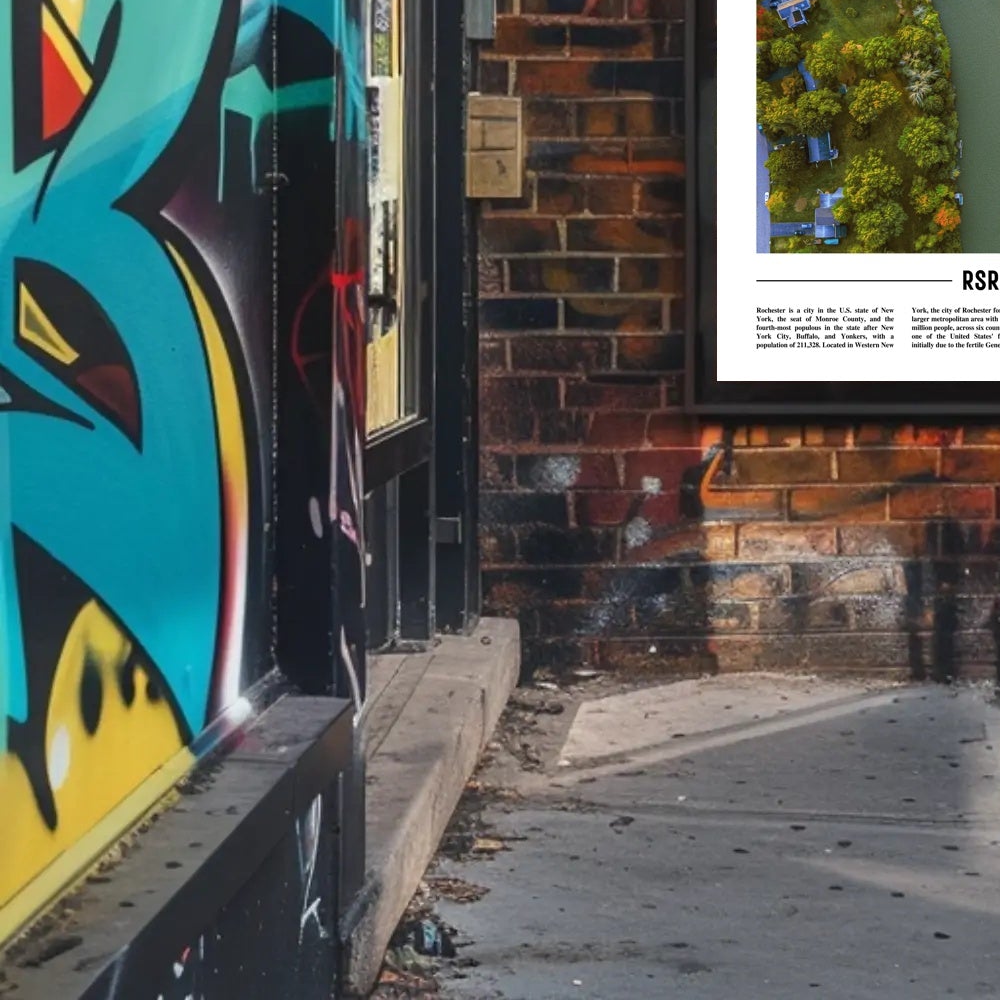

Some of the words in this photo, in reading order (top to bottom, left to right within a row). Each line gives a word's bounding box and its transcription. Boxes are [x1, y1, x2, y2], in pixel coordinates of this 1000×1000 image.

[962, 269, 1000, 291] RSR
[803, 307, 815, 315] city
[941, 307, 953, 315] city
[776, 315, 787, 323] the
[805, 315, 813, 323] of
[815, 315, 839, 323] Monroe
[869, 315, 882, 323] and
[884, 315, 895, 323] the
[911, 315, 930, 324] larger
[930, 315, 970, 324] metropolitan
[985, 315, 999, 323] with
[794, 324, 822, 333] populous
[756, 332, 772, 340] York
[824, 332, 836, 340] and
[755, 341, 789, 350] population
[788, 341, 796, 349] of
[822, 341, 847, 349] Located
[847, 341, 854, 349] in
[854, 341, 880, 349] Western
[880, 341, 895, 349] New
[911, 341, 935, 350] initially
[935, 341, 947, 349] due
[955, 341, 965, 349] the
[965, 341, 985, 349] fertile
